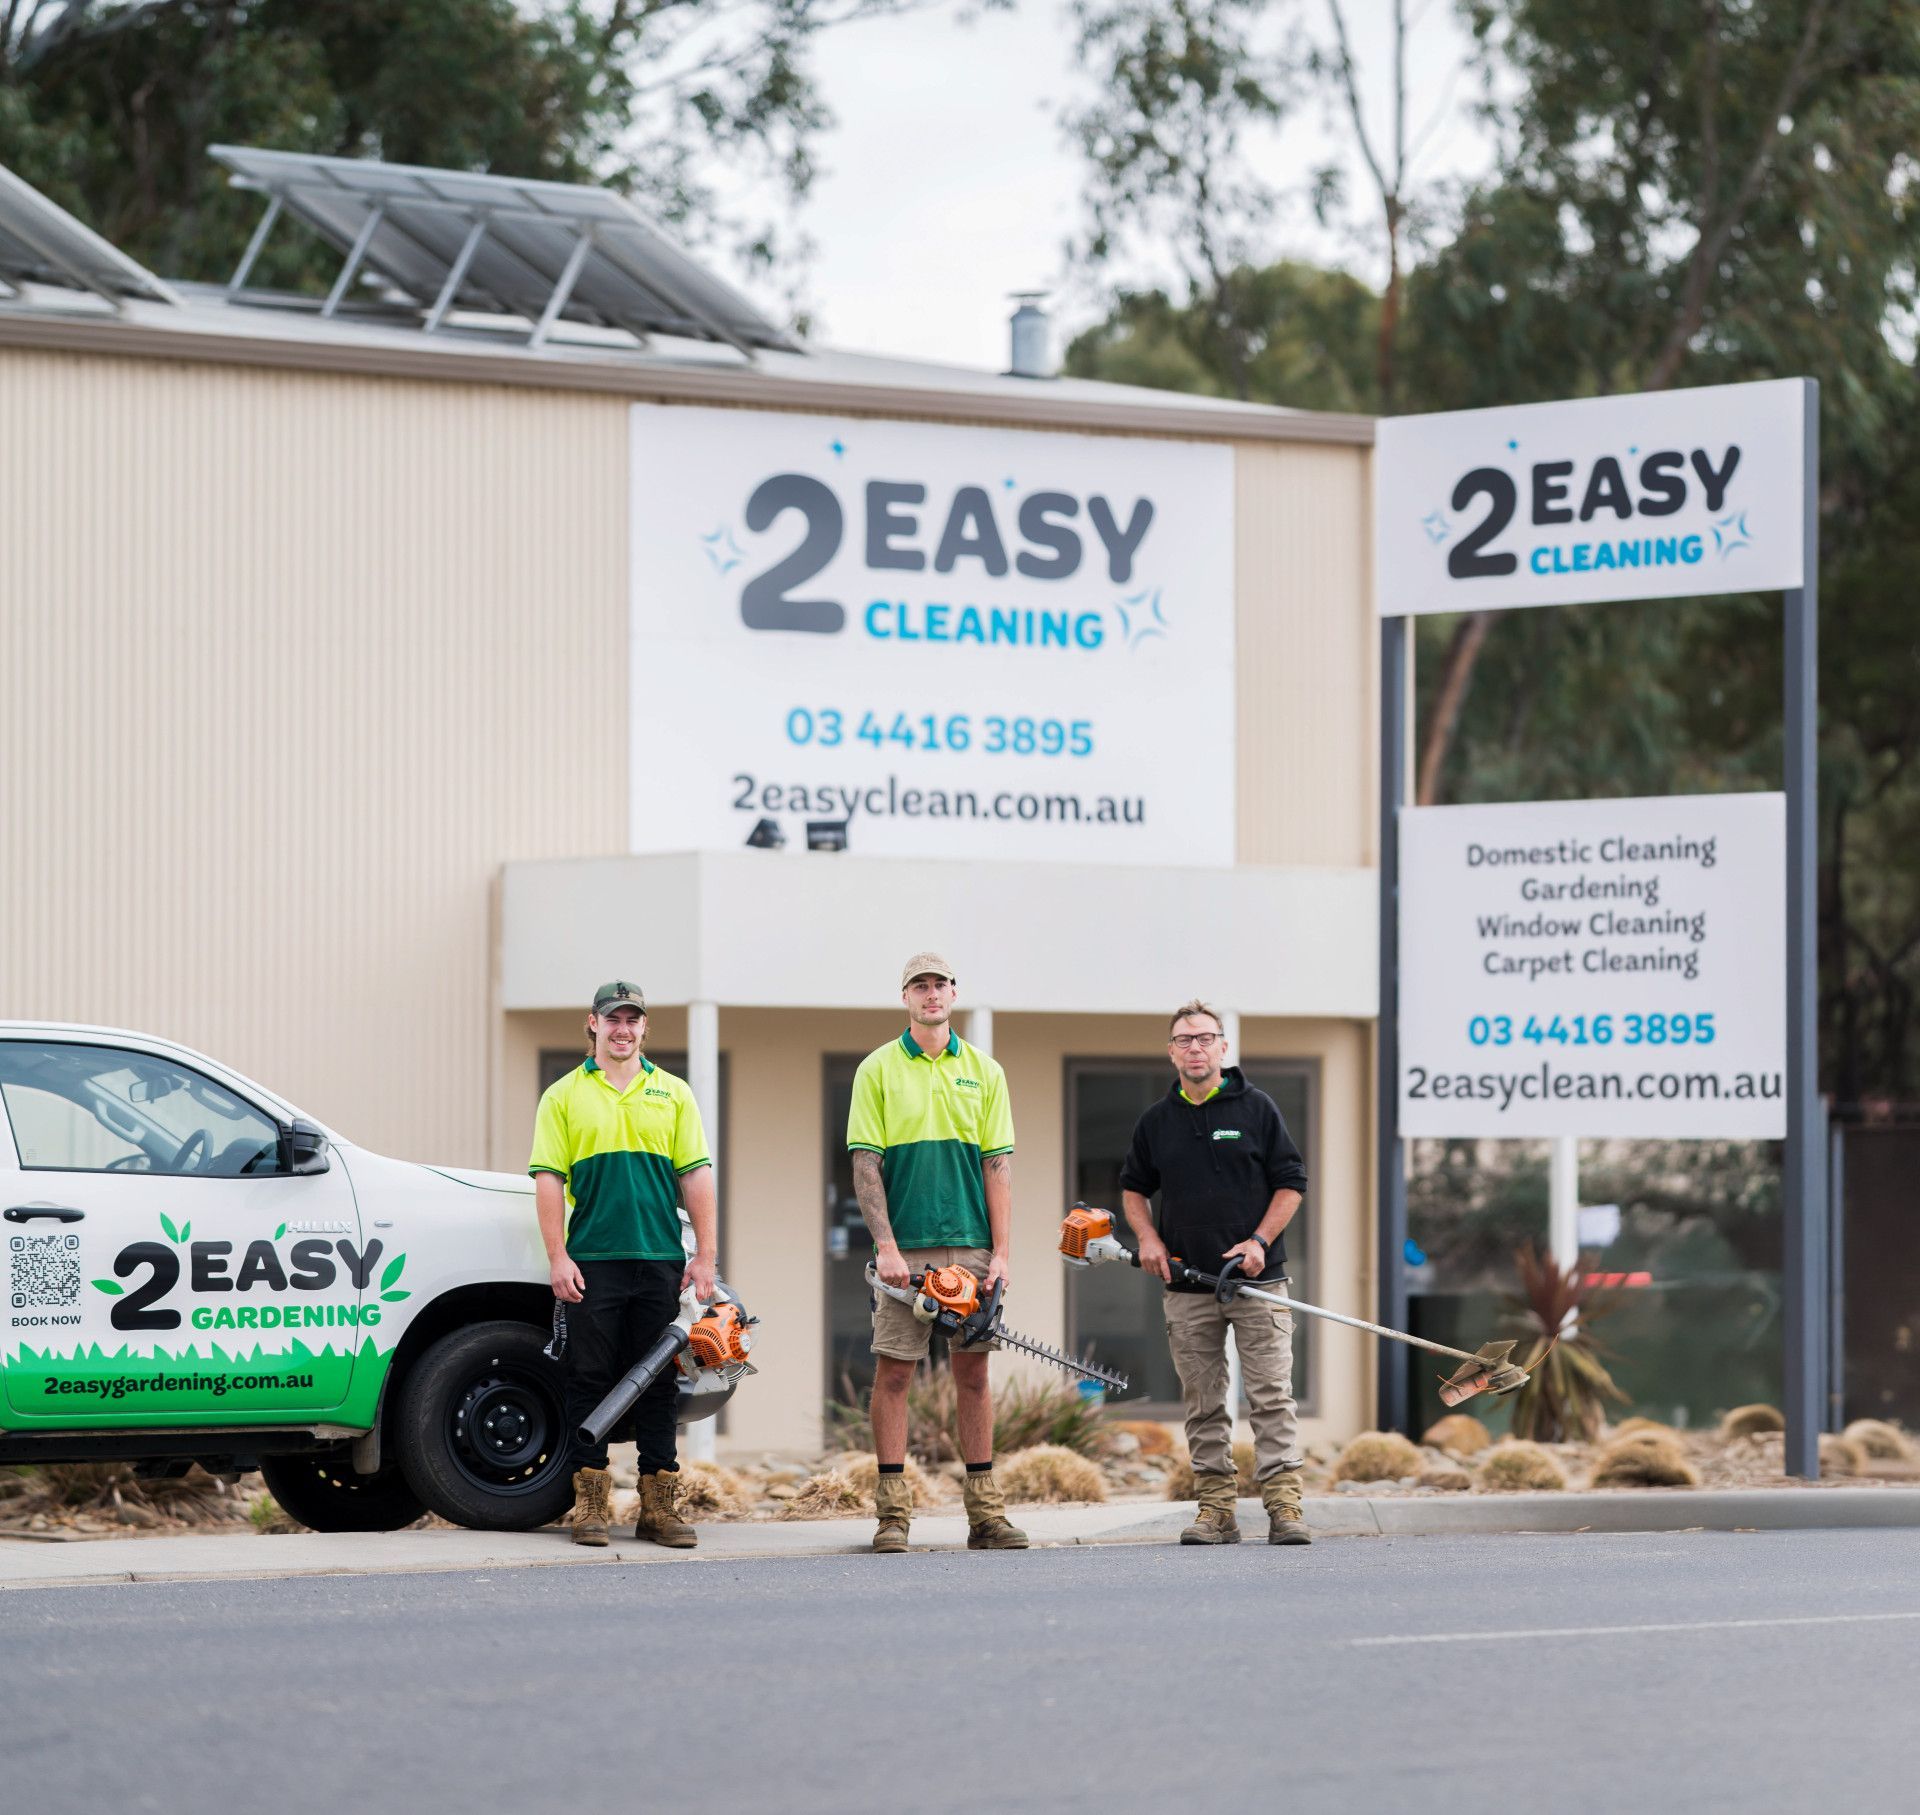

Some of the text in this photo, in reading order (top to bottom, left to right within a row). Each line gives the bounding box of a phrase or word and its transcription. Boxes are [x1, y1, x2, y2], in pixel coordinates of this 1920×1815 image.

[1530, 534, 1704, 575] CLEANING
[864, 601, 1105, 650] CLEANING
[786, 708, 1093, 758] 03 4416 3895
[733, 774, 1145, 826] 2easyclean.com.au
[1467, 835, 1717, 868] Domestic Cleaning
[1521, 875, 1659, 906] Gardening
[1477, 910, 1706, 942] Window Cleaning
[1483, 947, 1699, 981] Carpet Cleaning
[1468, 1012, 1716, 1046] 03 4416 3895
[1407, 1062, 1782, 1112] 2easyclean.com.au
[11, 1315, 82, 1327] BOOK NOW
[191, 1303, 382, 1330] GARDENING
[44, 1372, 314, 1399] 2easygardening.com.au
